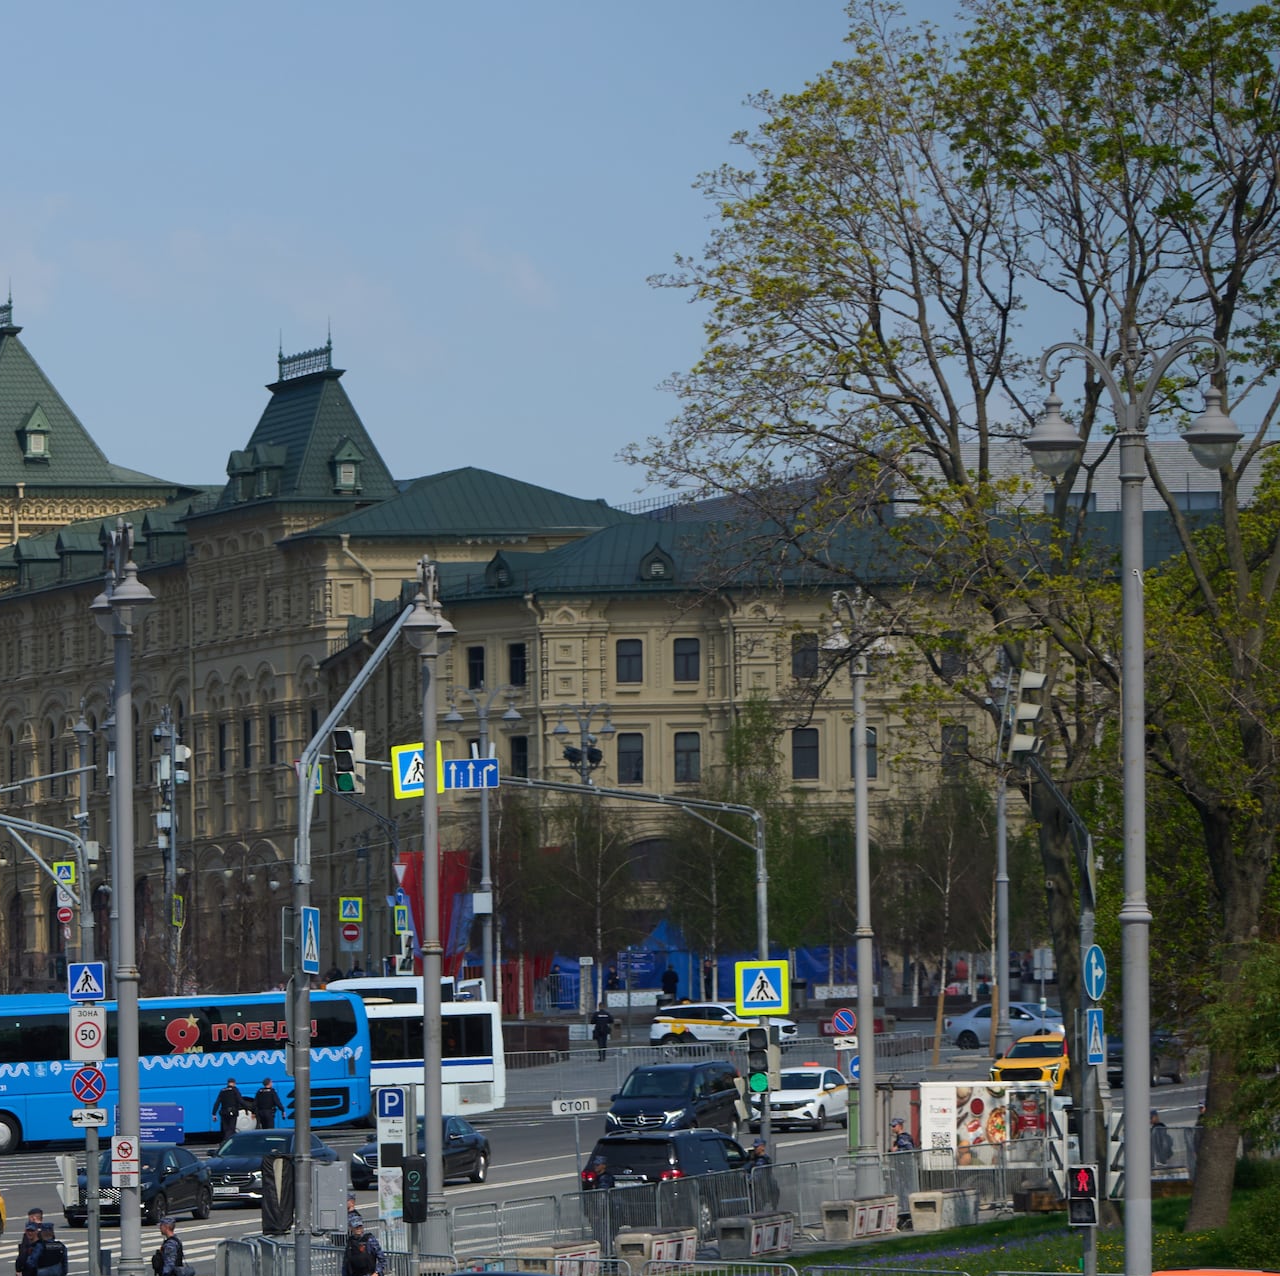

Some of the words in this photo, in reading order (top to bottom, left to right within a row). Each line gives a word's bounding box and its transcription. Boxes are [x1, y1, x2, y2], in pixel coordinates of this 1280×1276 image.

[77, 1010, 98, 1018] ЗОНА
[81, 1029, 96, 1041] 50
[165, 1017, 200, 1054] 9
[560, 1100, 590, 1112] СТОП
